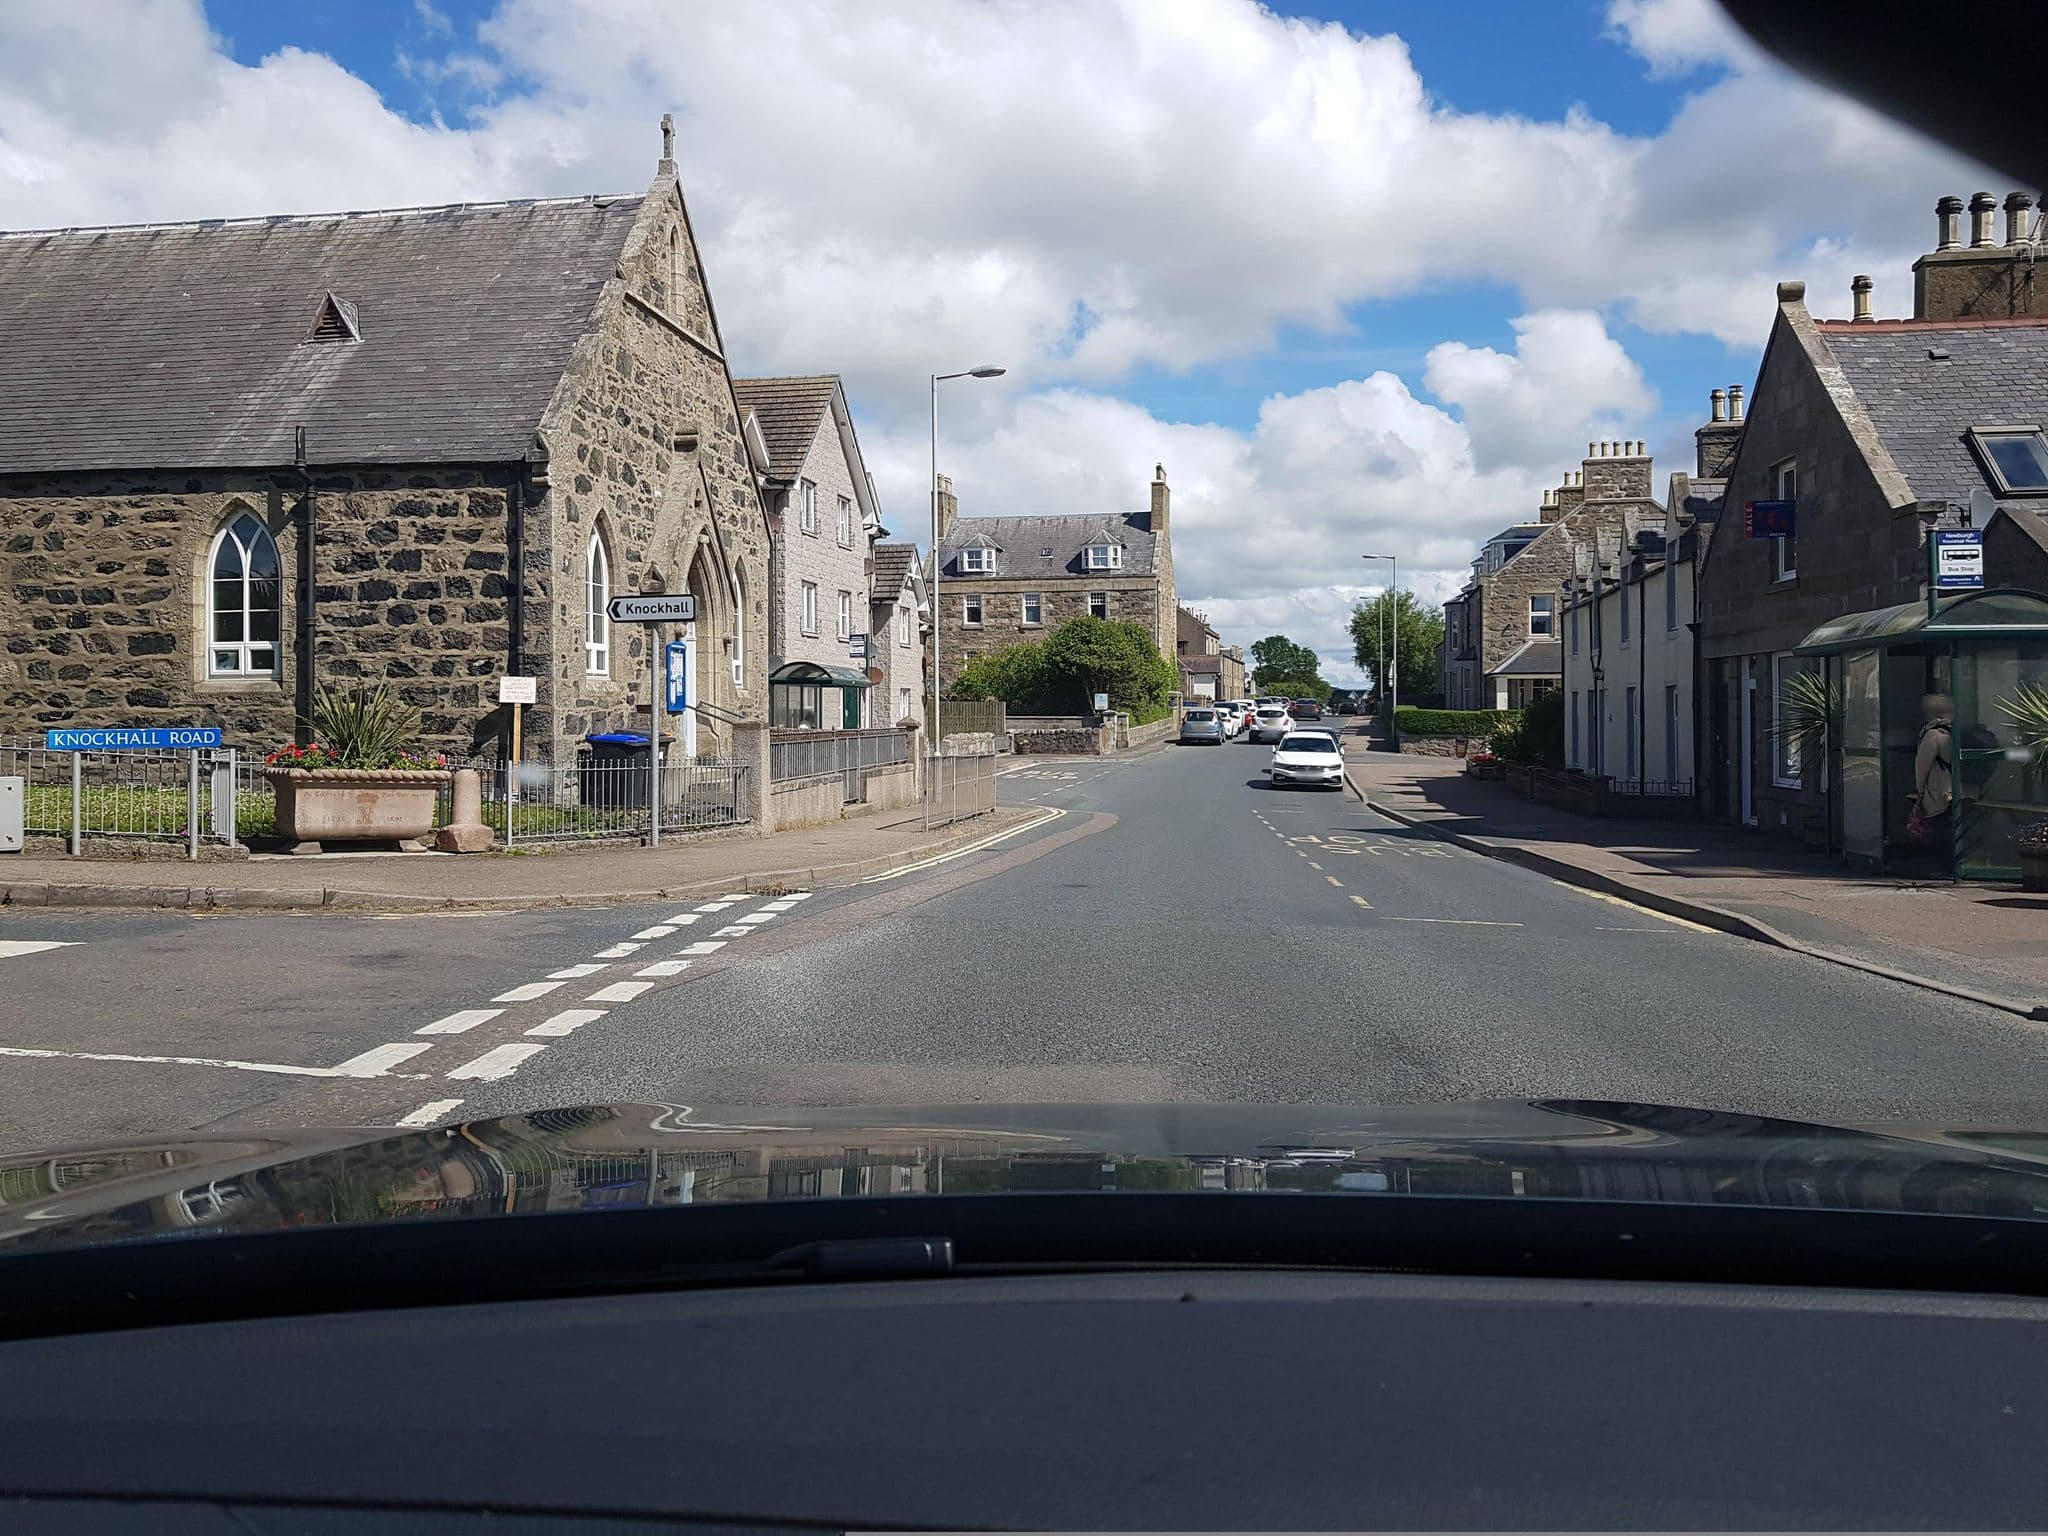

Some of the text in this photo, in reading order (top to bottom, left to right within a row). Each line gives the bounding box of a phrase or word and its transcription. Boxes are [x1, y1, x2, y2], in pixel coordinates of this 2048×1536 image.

[625, 601, 689, 615] Knockhall
[54, 731, 216, 746] KNOCKHALL ROAD
[1319, 844, 1454, 858] BUS
